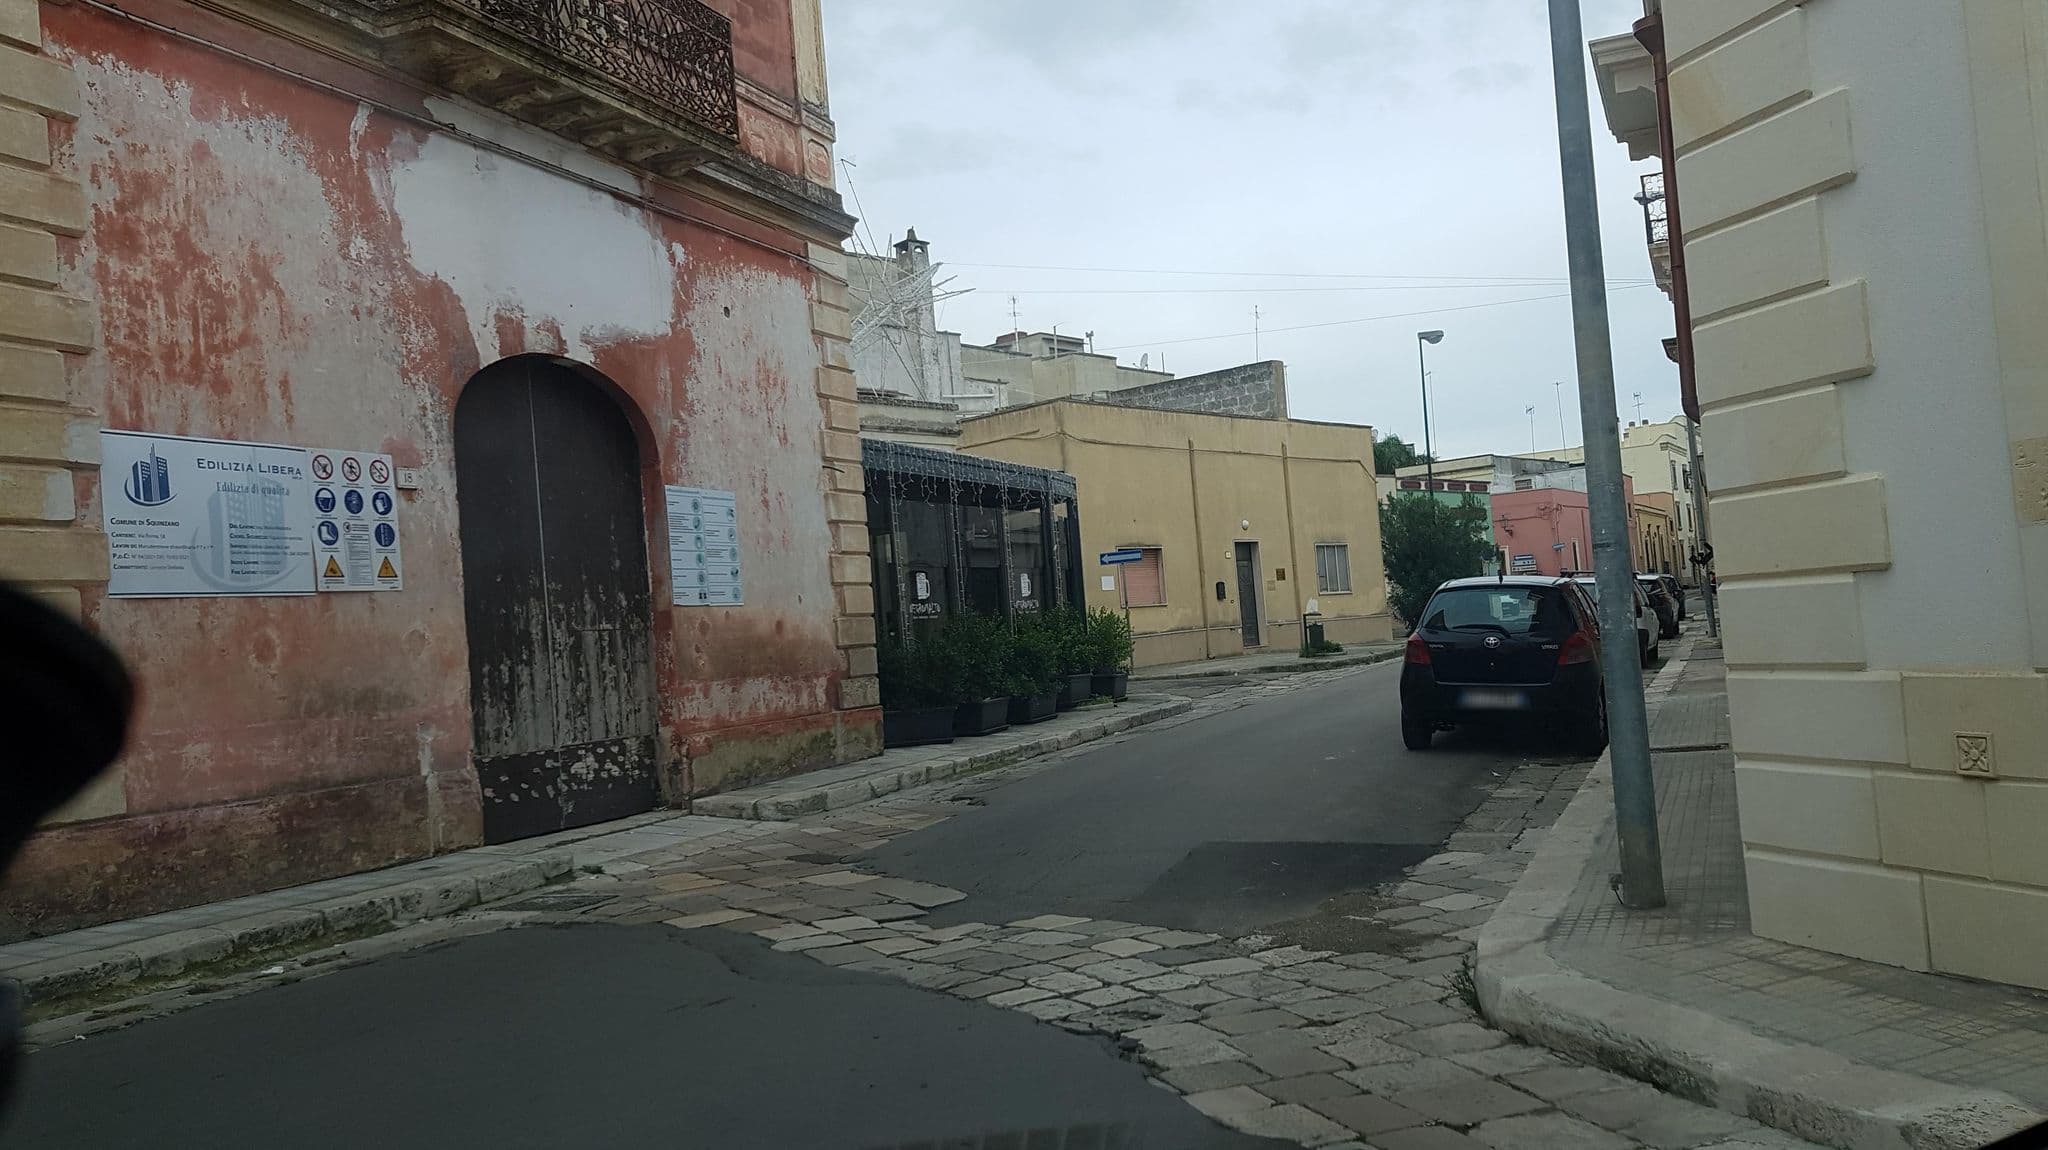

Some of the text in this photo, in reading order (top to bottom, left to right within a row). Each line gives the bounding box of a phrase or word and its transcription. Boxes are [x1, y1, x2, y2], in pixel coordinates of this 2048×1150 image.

[197, 458, 302, 476] EDILIZIA LIBERA
[251, 483, 259, 495] di
[110, 518, 137, 526] COMUNE
[146, 518, 180, 528] SQUINZANO
